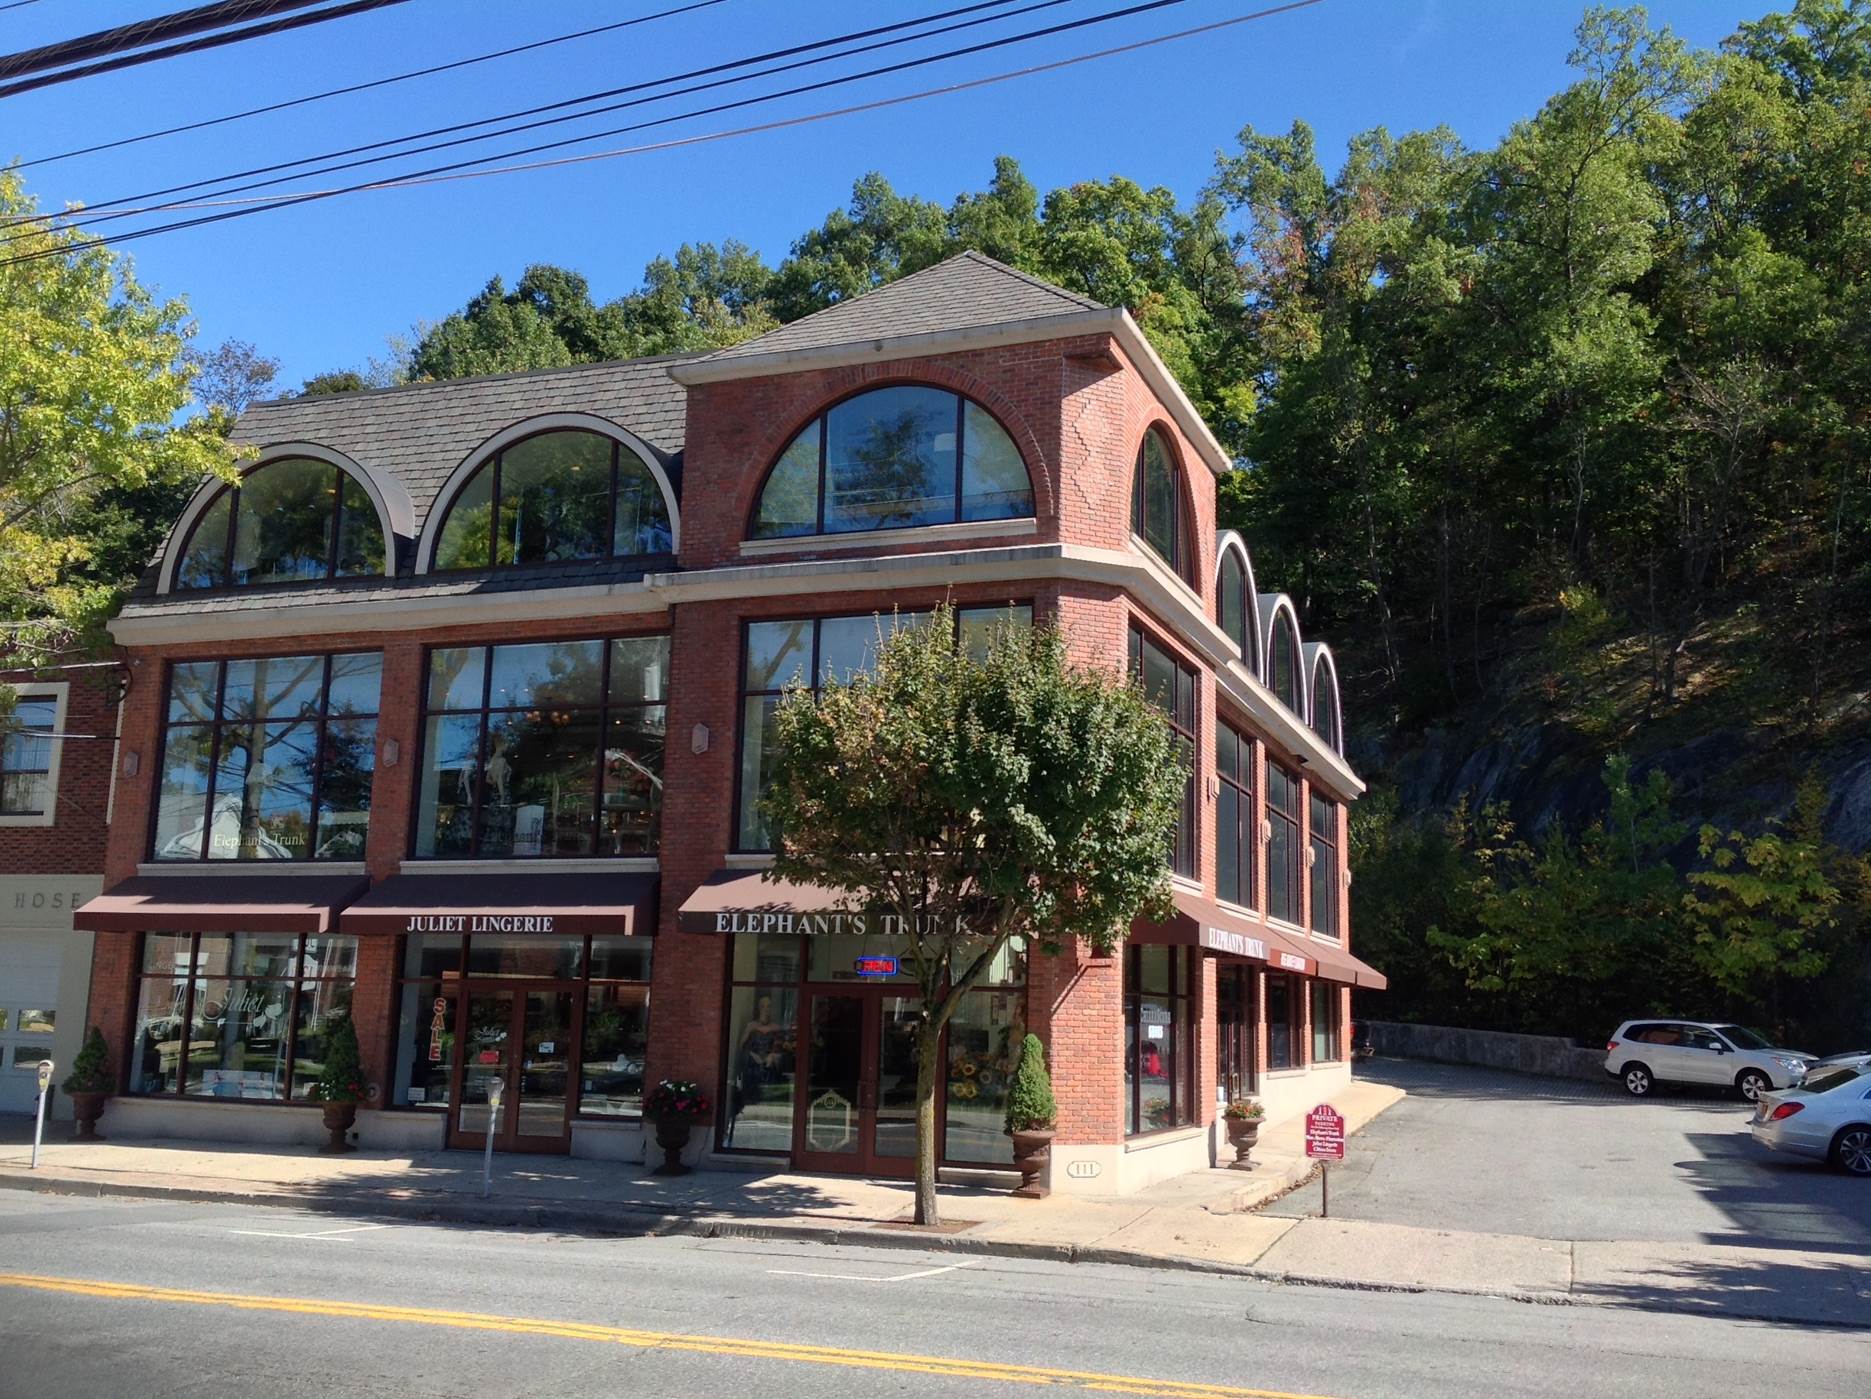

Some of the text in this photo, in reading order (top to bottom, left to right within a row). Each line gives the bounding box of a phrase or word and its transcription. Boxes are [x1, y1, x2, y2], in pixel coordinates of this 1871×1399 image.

[273, 832, 306, 846] Trunk
[14, 892, 80, 909] HOSE
[406, 916, 553, 933] JULIET LINGERIE
[715, 913, 866, 935] ELEPHANT'S
[203, 987, 265, 1020] Juliet
[429, 998, 446, 1061] SALE
[1076, 1163, 1094, 1175] 111
